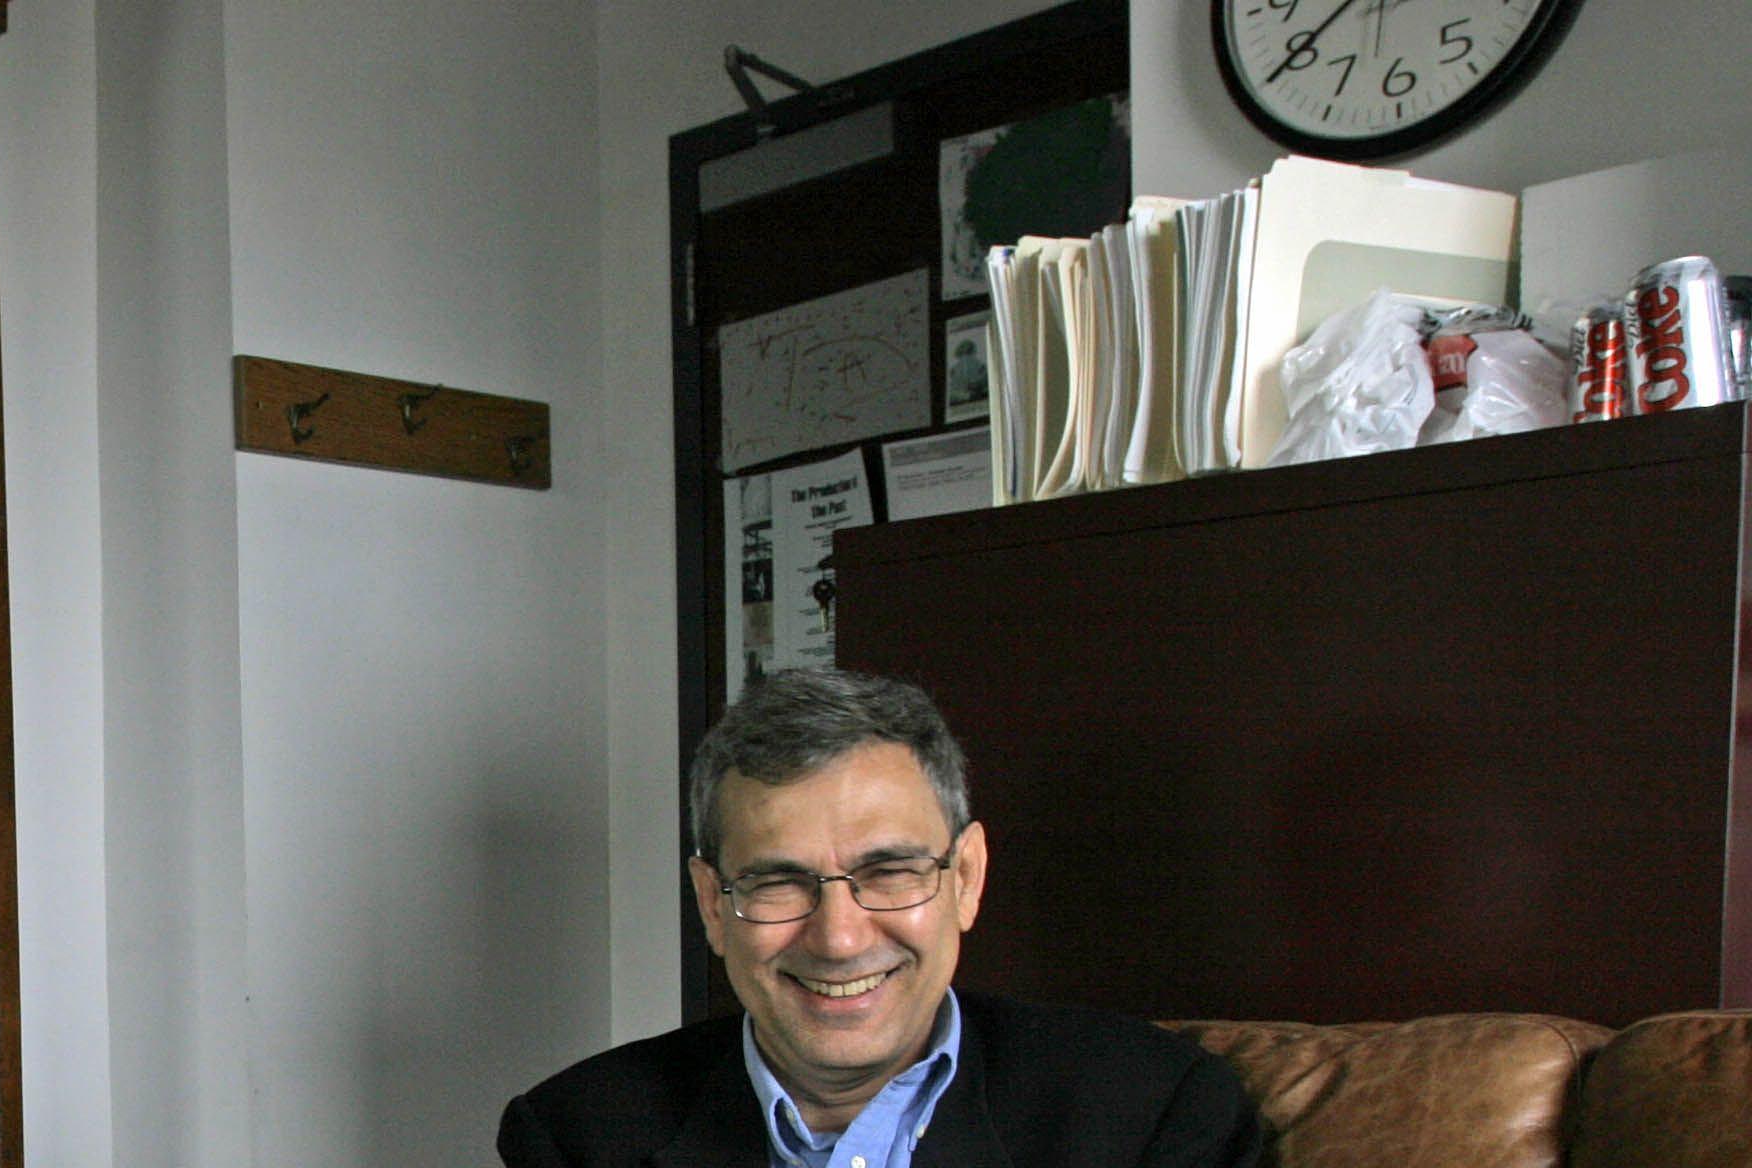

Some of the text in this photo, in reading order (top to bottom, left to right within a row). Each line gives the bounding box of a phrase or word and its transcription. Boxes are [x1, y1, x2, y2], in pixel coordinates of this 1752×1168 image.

[1286, 31, 1318, 70] 8
[1439, 18, 1472, 64] 5
[1328, 54, 1357, 96] 7
[1382, 58, 1416, 97] 6
[1574, 320, 1627, 421] oke
[1635, 286, 1690, 414] Coke
